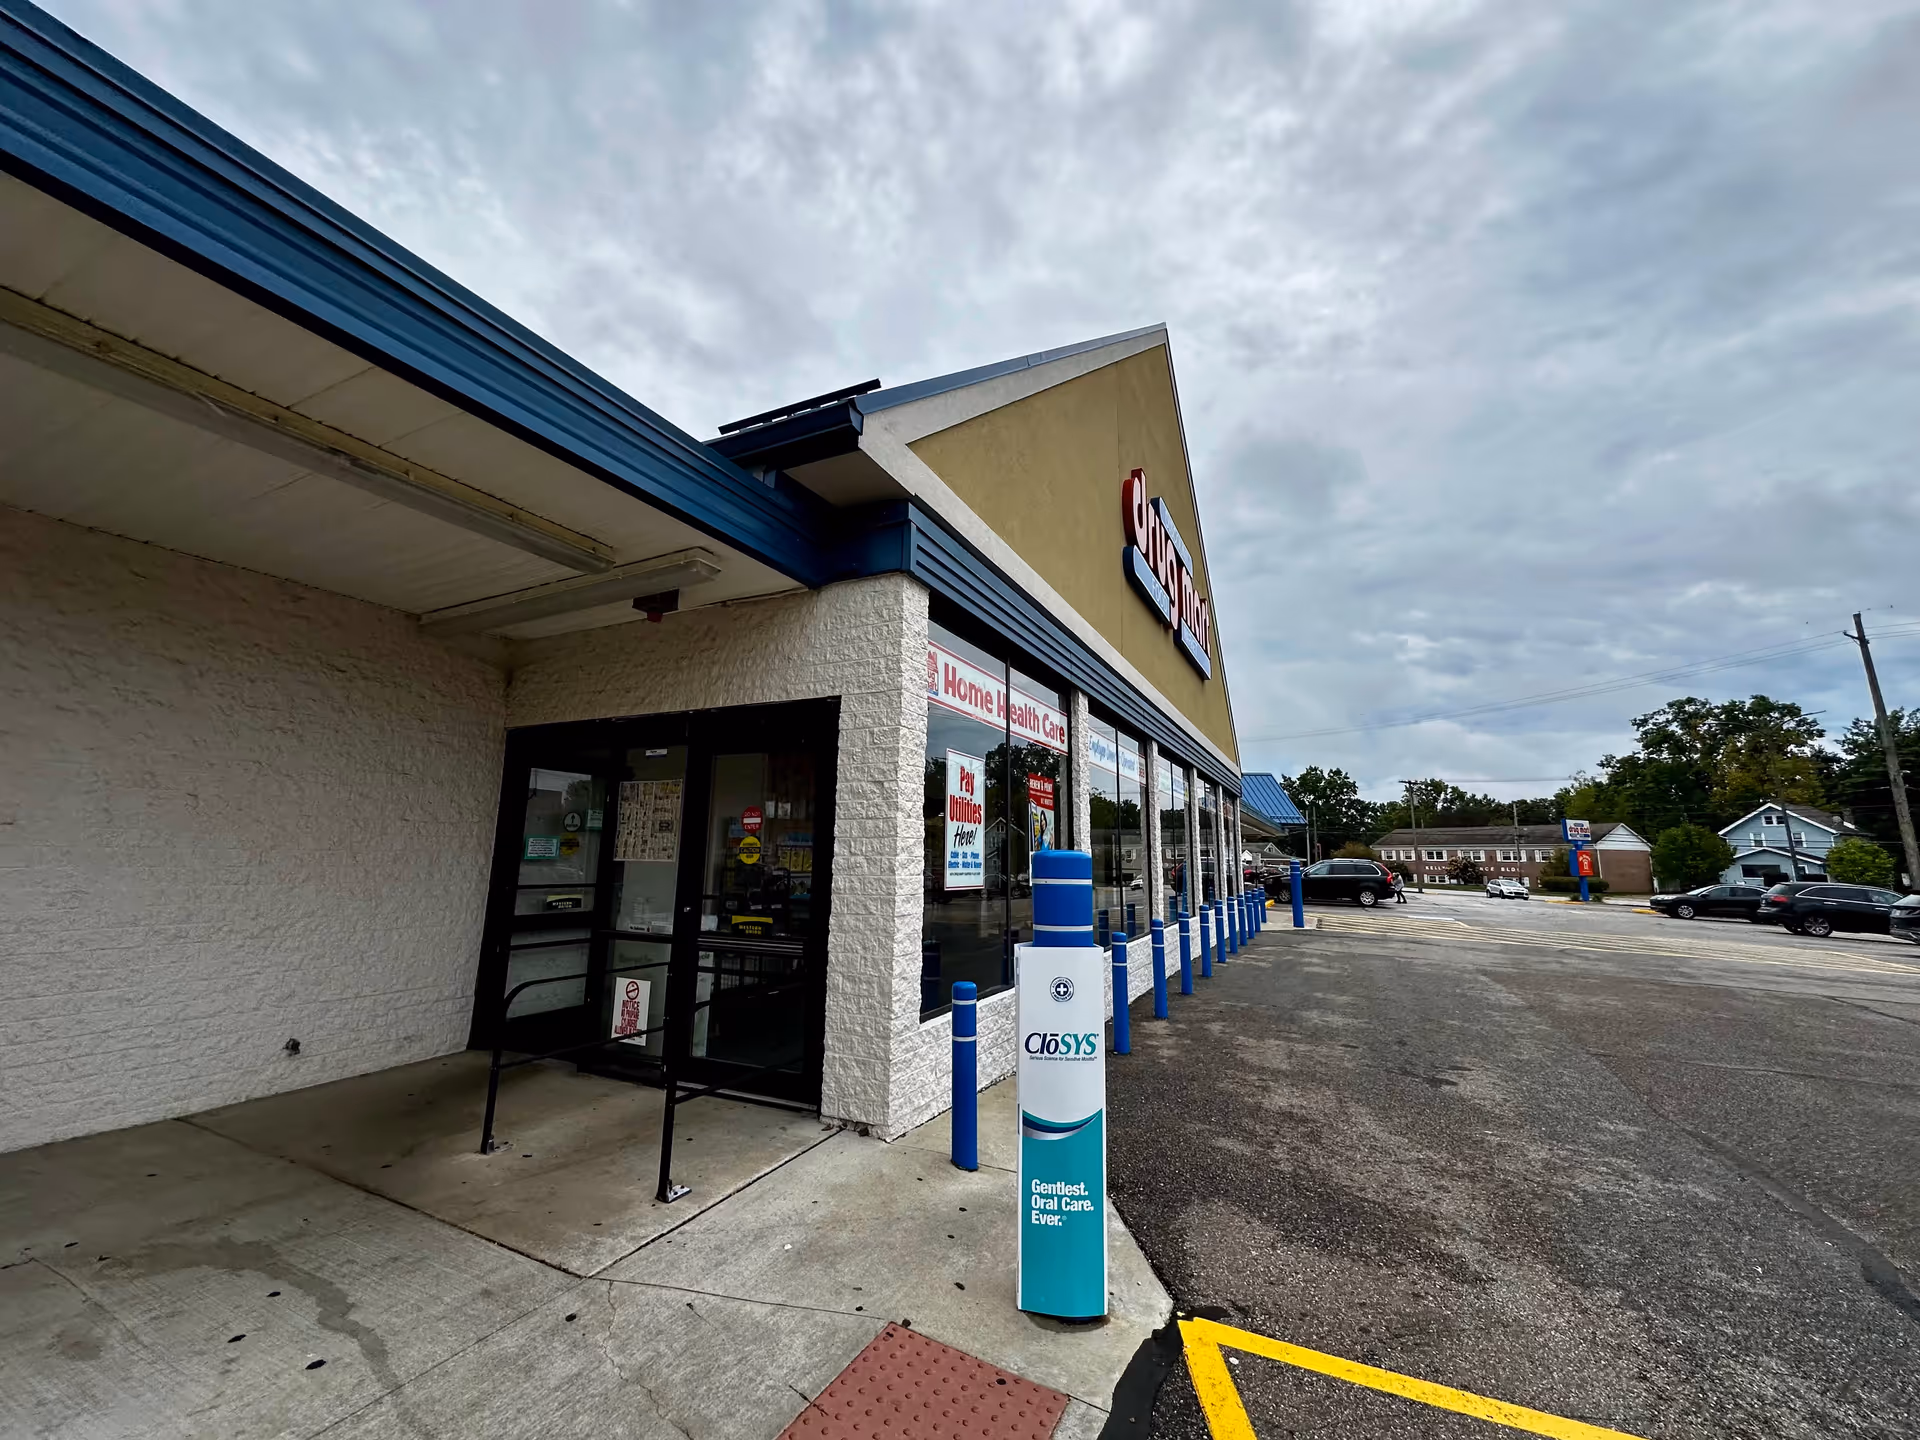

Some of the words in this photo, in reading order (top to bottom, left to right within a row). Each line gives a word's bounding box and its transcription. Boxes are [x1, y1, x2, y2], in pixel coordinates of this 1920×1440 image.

[1124, 468, 1179, 630] drug
[1182, 567, 1211, 658] mart
[944, 662, 993, 714] Home
[997, 690, 1039, 734] Health
[1042, 713, 1065, 744] Care
[960, 765, 974, 796] Pay
[950, 794, 982, 825] Utilities
[953, 824, 977, 848] Here!
[622, 1000, 640, 1010] NOTICE
[1031, 1178, 1088, 1196] Gentlest.
[1031, 1194, 1058, 1210] Oral
[1061, 1196, 1094, 1211] Care.
[1031, 1210, 1062, 1226] Ever.
